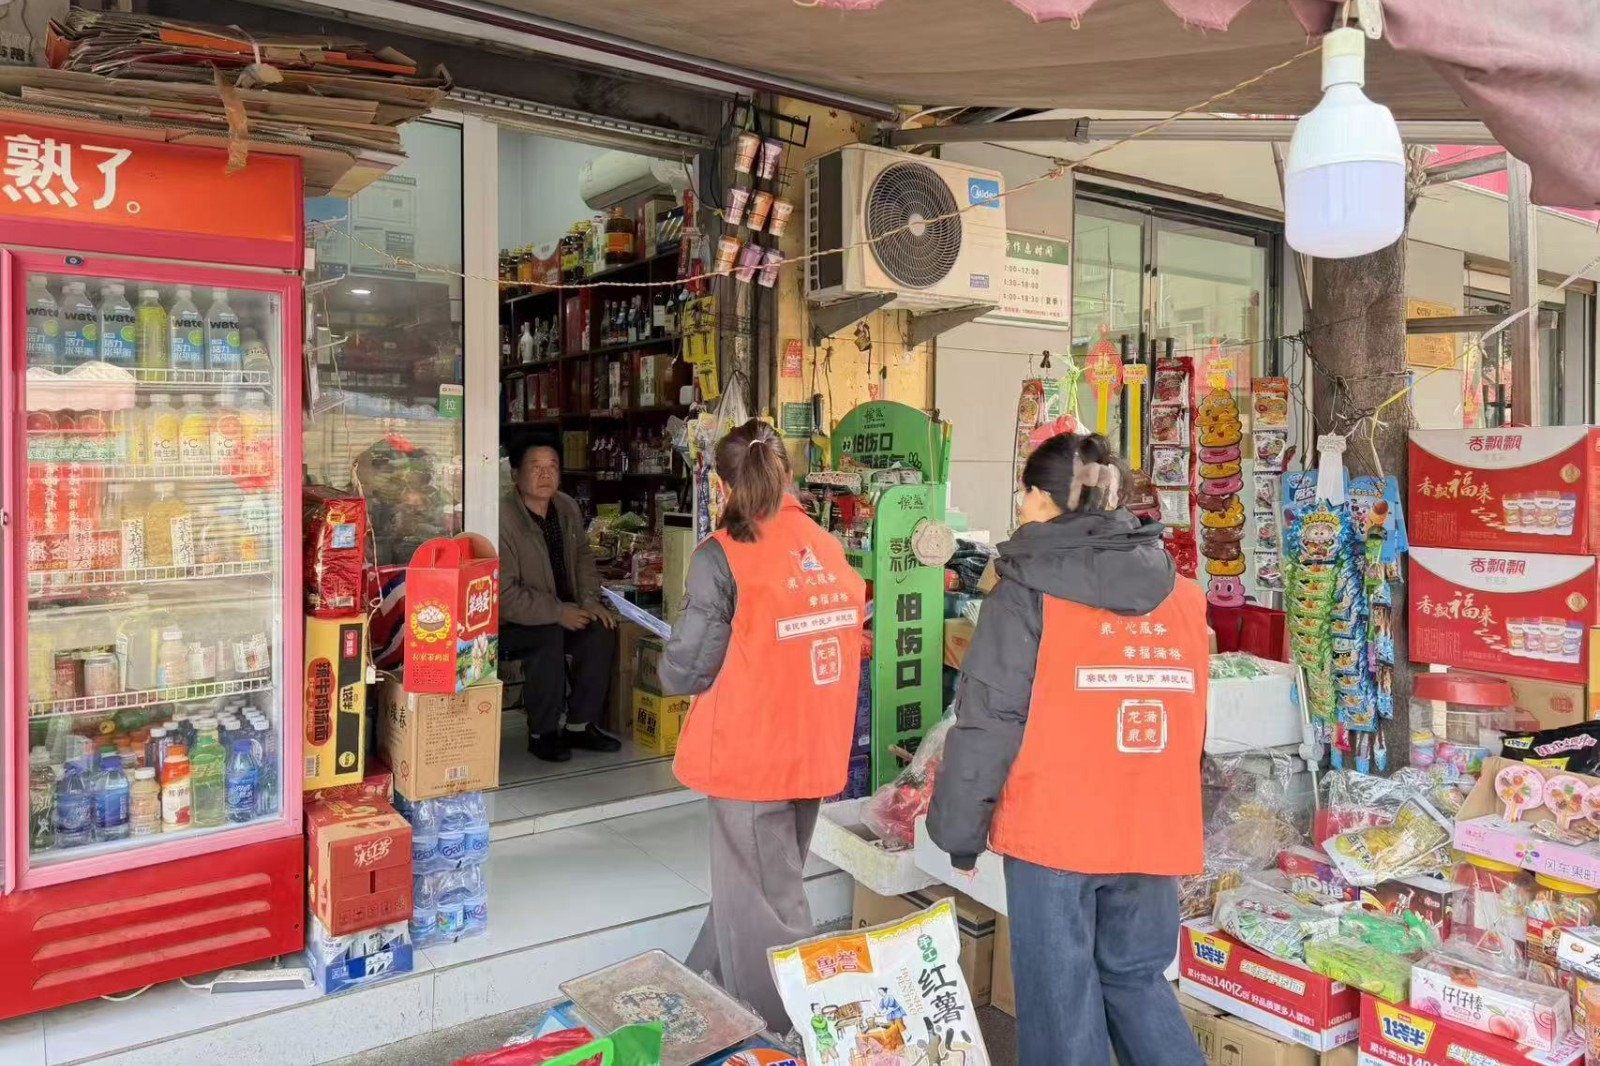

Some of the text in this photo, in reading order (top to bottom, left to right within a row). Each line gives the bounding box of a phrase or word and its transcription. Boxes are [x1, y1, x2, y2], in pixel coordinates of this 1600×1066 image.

[445, 399, 457, 411] 拉
[1465, 434, 1523, 452] 香飘飘
[1416, 469, 1495, 505] 香飘福来
[1467, 557, 1527, 576] 香飘飘
[1415, 590, 1498, 628] 香飘福来
[895, 592, 923, 690] 怕伤口
[1122, 645, 1183, 661] 幸福满格
[1383, 1016, 1426, 1047] 1袋半
